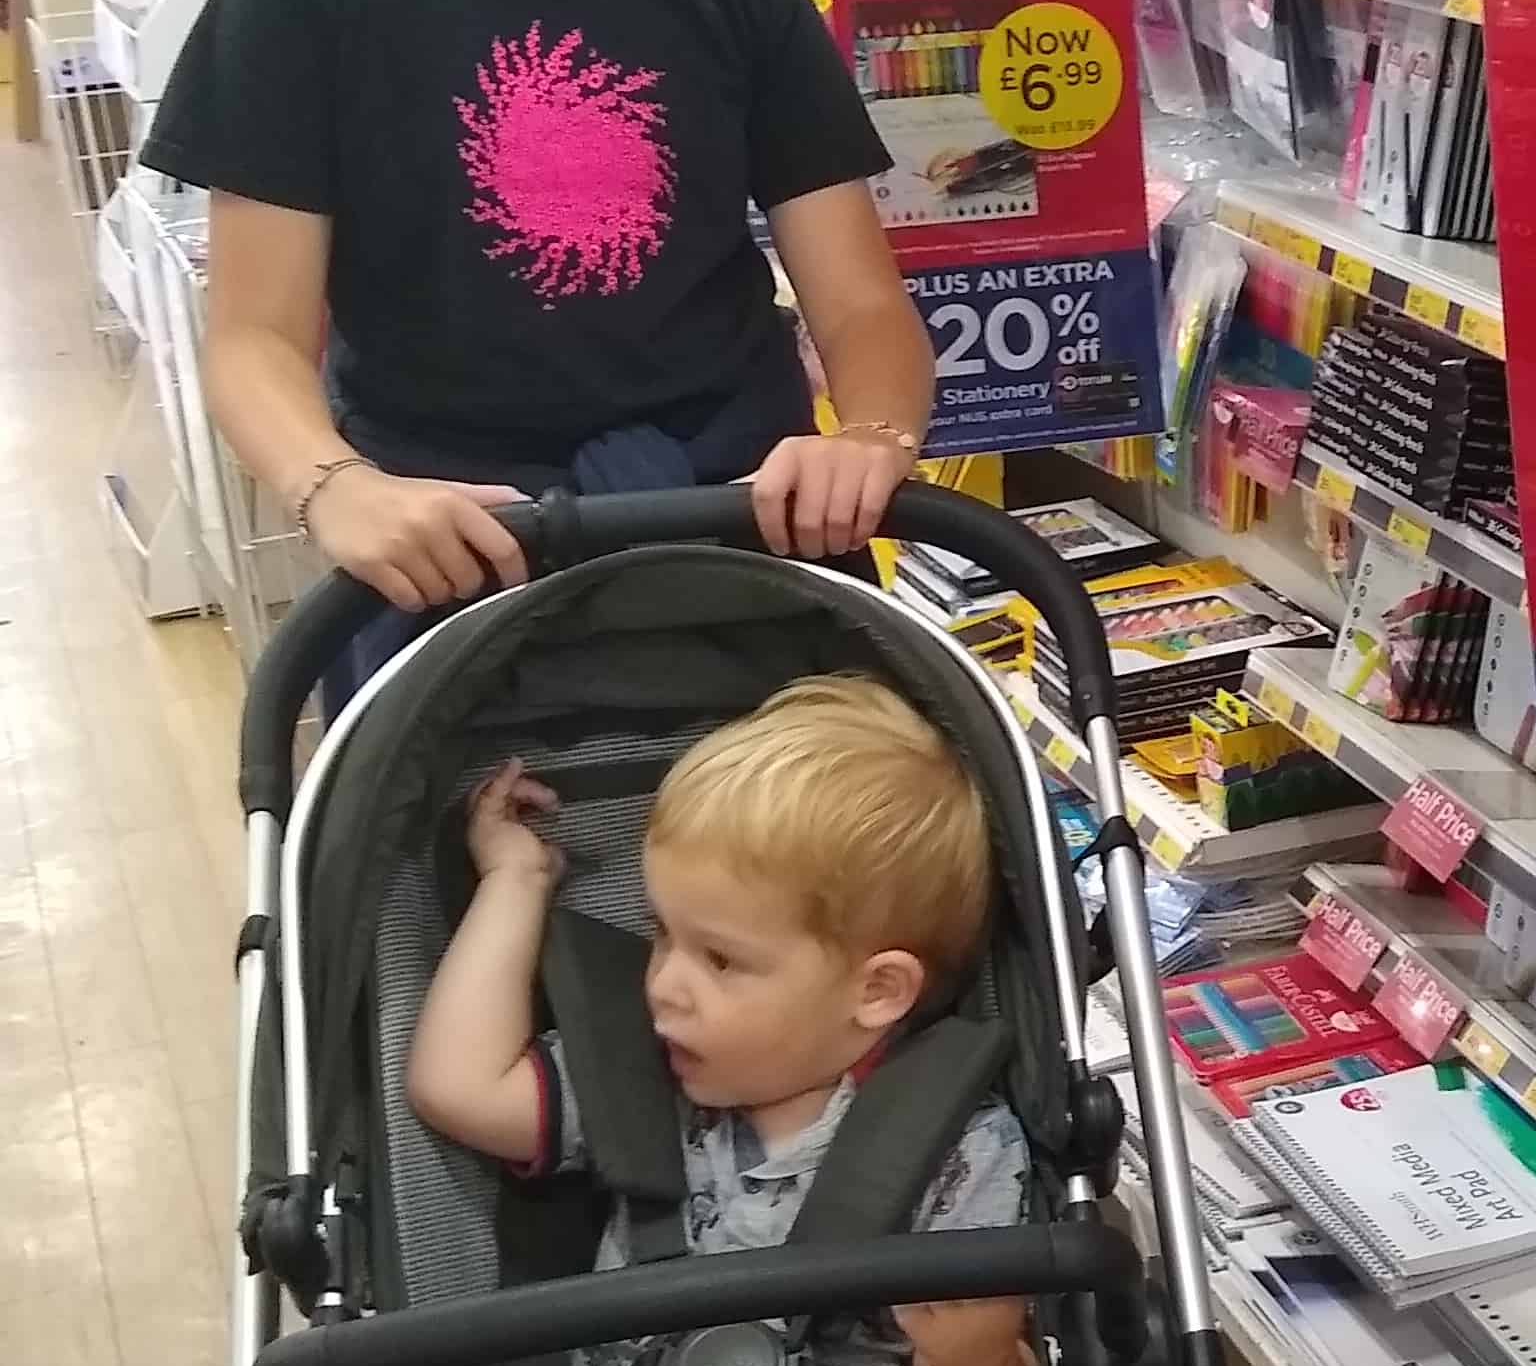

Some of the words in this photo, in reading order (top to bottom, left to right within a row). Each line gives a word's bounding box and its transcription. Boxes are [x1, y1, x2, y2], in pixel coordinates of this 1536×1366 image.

[978, 269, 1018, 290] AN
[1025, 259, 1114, 287] EXTRA
[1057, 340, 1101, 365] off
[943, 380, 1050, 406] Stationery
[1405, 777, 1442, 820] Half
[1441, 802, 1477, 849] Price
[1316, 895, 1347, 932] Half
[1346, 918, 1383, 960] Price
[1422, 981, 1459, 1028] Price
[1392, 1142, 1441, 1186] Media
[1450, 1170, 1492, 1198] Pad
[1427, 1186, 1489, 1231] Mixed
[1485, 1196, 1524, 1222] Art
